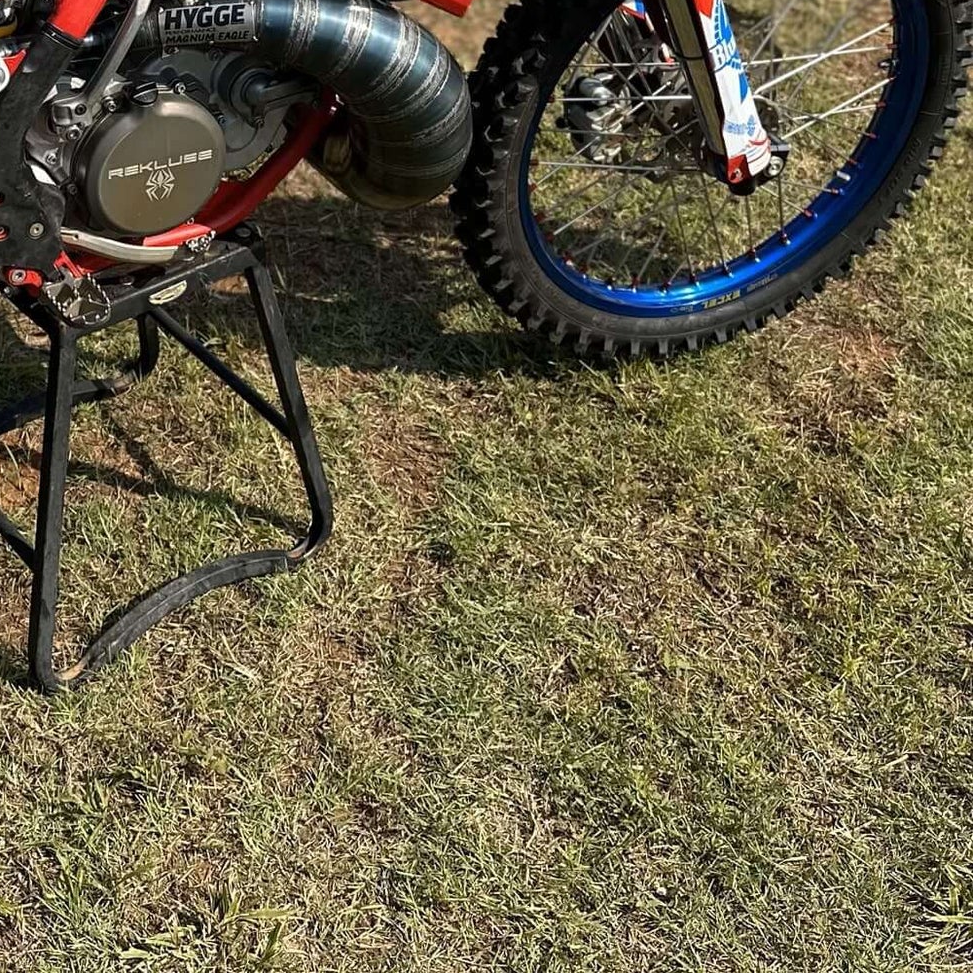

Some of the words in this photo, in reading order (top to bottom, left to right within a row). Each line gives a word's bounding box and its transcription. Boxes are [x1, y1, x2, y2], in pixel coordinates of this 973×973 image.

[164, 4, 246, 30] HYGGE
[165, 31, 215, 44] MAGNUM
[218, 30, 250, 41] EAGLE
[108, 149, 213, 180] REKLUSE
